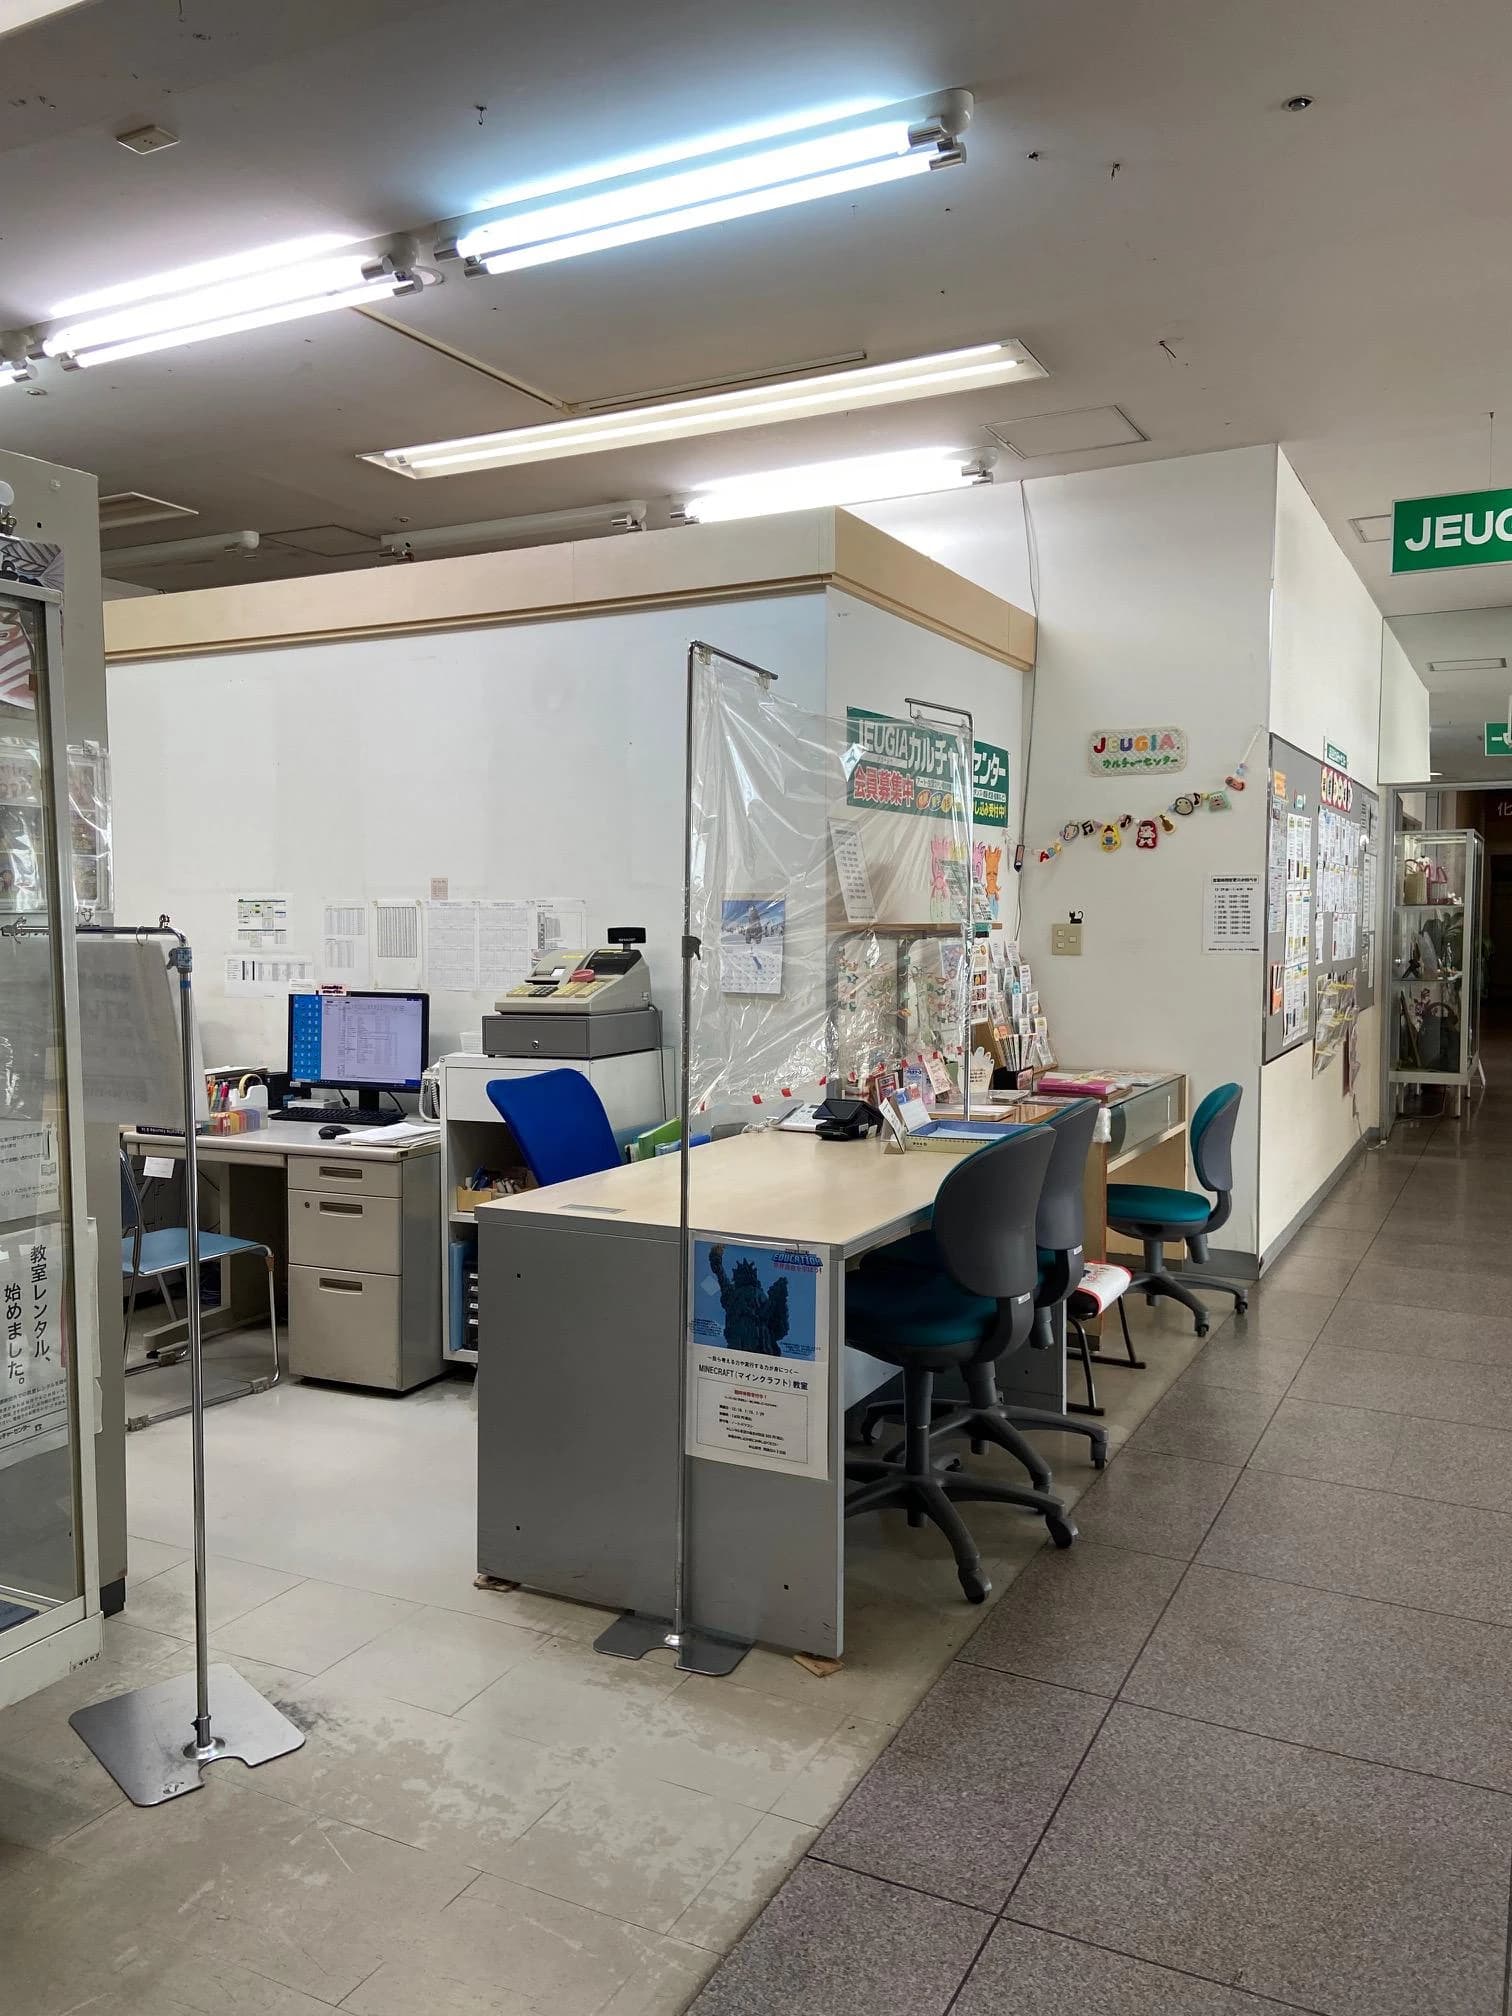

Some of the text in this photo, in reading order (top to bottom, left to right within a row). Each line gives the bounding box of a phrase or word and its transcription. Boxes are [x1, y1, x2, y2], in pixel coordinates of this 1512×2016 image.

[853, 764, 915, 807] 会員募集中
[4, 1282, 25, 1385] 始めました。
[30, 1244, 51, 1362] 教室レンタル、
